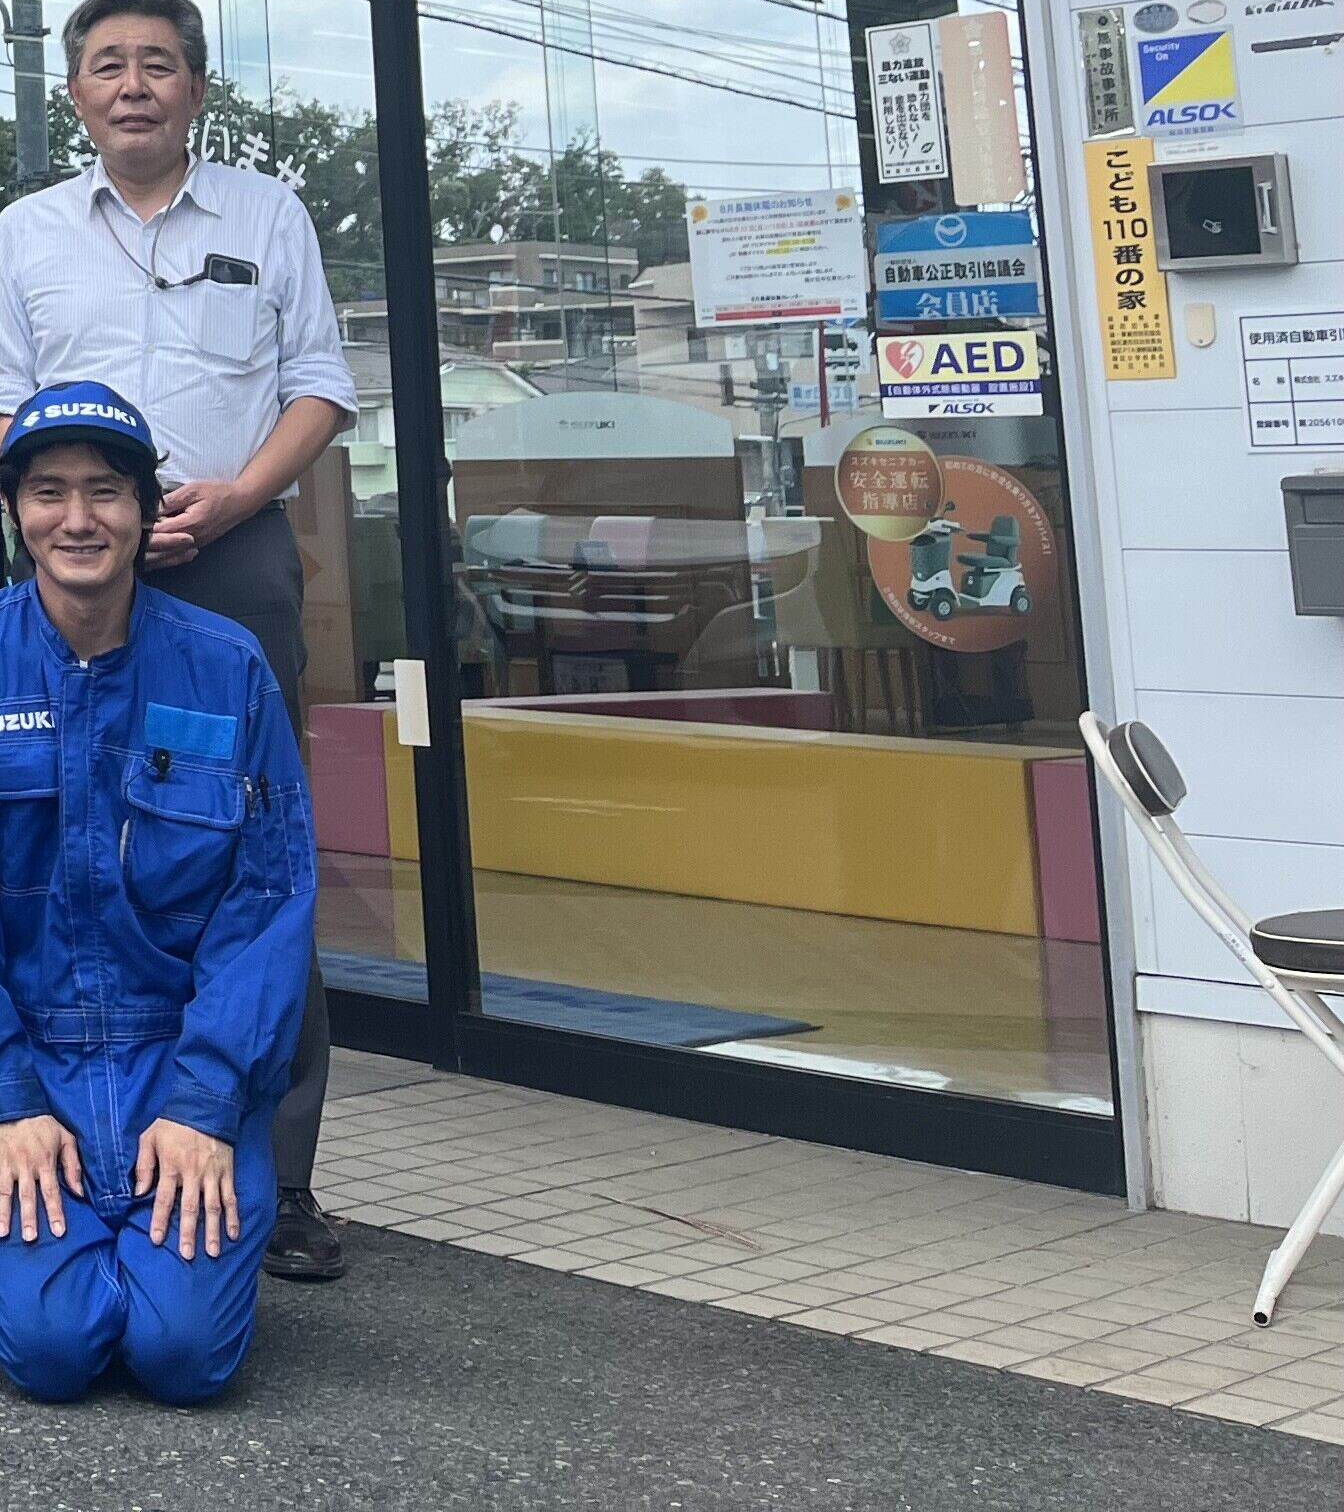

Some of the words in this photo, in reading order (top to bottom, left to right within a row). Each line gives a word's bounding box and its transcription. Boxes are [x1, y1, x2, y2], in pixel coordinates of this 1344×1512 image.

[1143, 42, 1180, 54] Security
[1155, 52, 1169, 62] On
[1147, 101, 1237, 126] ALSOK
[1103, 150, 1149, 310] こども110番の家
[885, 258, 1026, 284] 自動車公正取引協議会
[1249, 328, 1344, 345] 使用済自動車引
[931, 341, 1025, 375] AED
[44, 402, 137, 427] SUZUKI
[942, 403, 994, 414] ALSOK
[850, 470, 930, 490] 安全運転
[862, 492, 919, 510] 指導店
